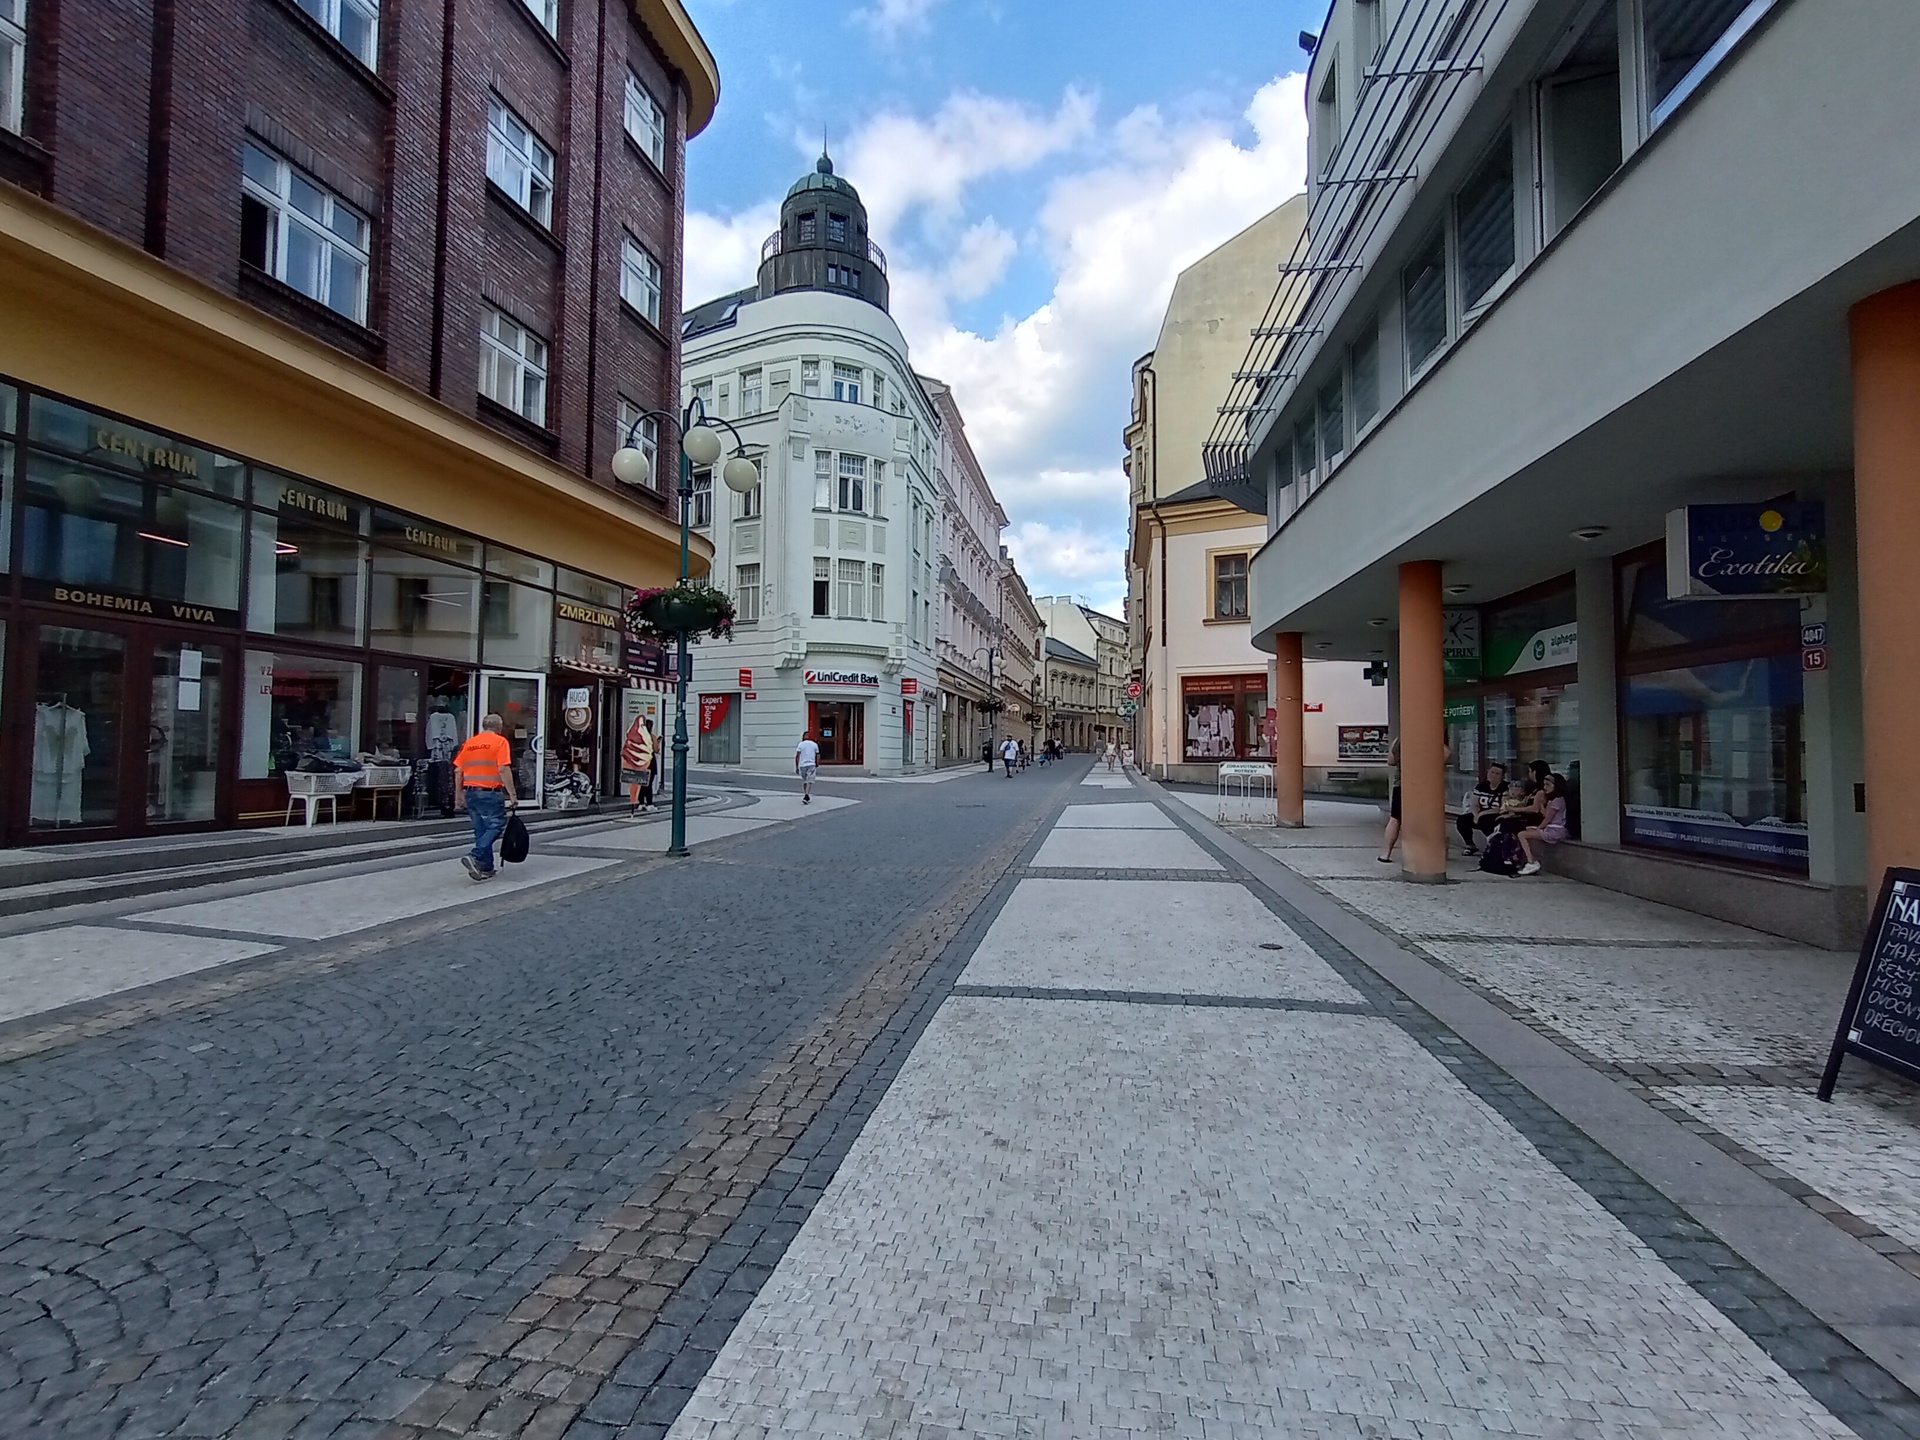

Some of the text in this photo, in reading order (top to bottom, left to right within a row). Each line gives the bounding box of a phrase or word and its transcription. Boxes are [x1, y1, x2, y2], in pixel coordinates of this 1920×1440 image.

[96, 430, 198, 476] CENTRUM
[280, 487, 348, 522] CENTRUM
[404, 526, 457, 553] CENTRUM
[1698, 546, 1819, 578] Exotika
[54, 587, 216, 623] BOHEMIA VIVA
[559, 603, 616, 629] ZMRZLINA
[1550, 633, 1577, 647] alphega
[1442, 647, 1475, 658] SPIRIN
[1807, 652, 1821, 666] 15
[817, 671, 879, 684] UniCredit Bank
[569, 691, 587, 703] HUGO
[701, 696, 723, 705] Expert
[1449, 704, 1475, 717] POTŘEBY
[1889, 896, 1920, 925] NA
[1882, 941, 1920, 965] MAK
